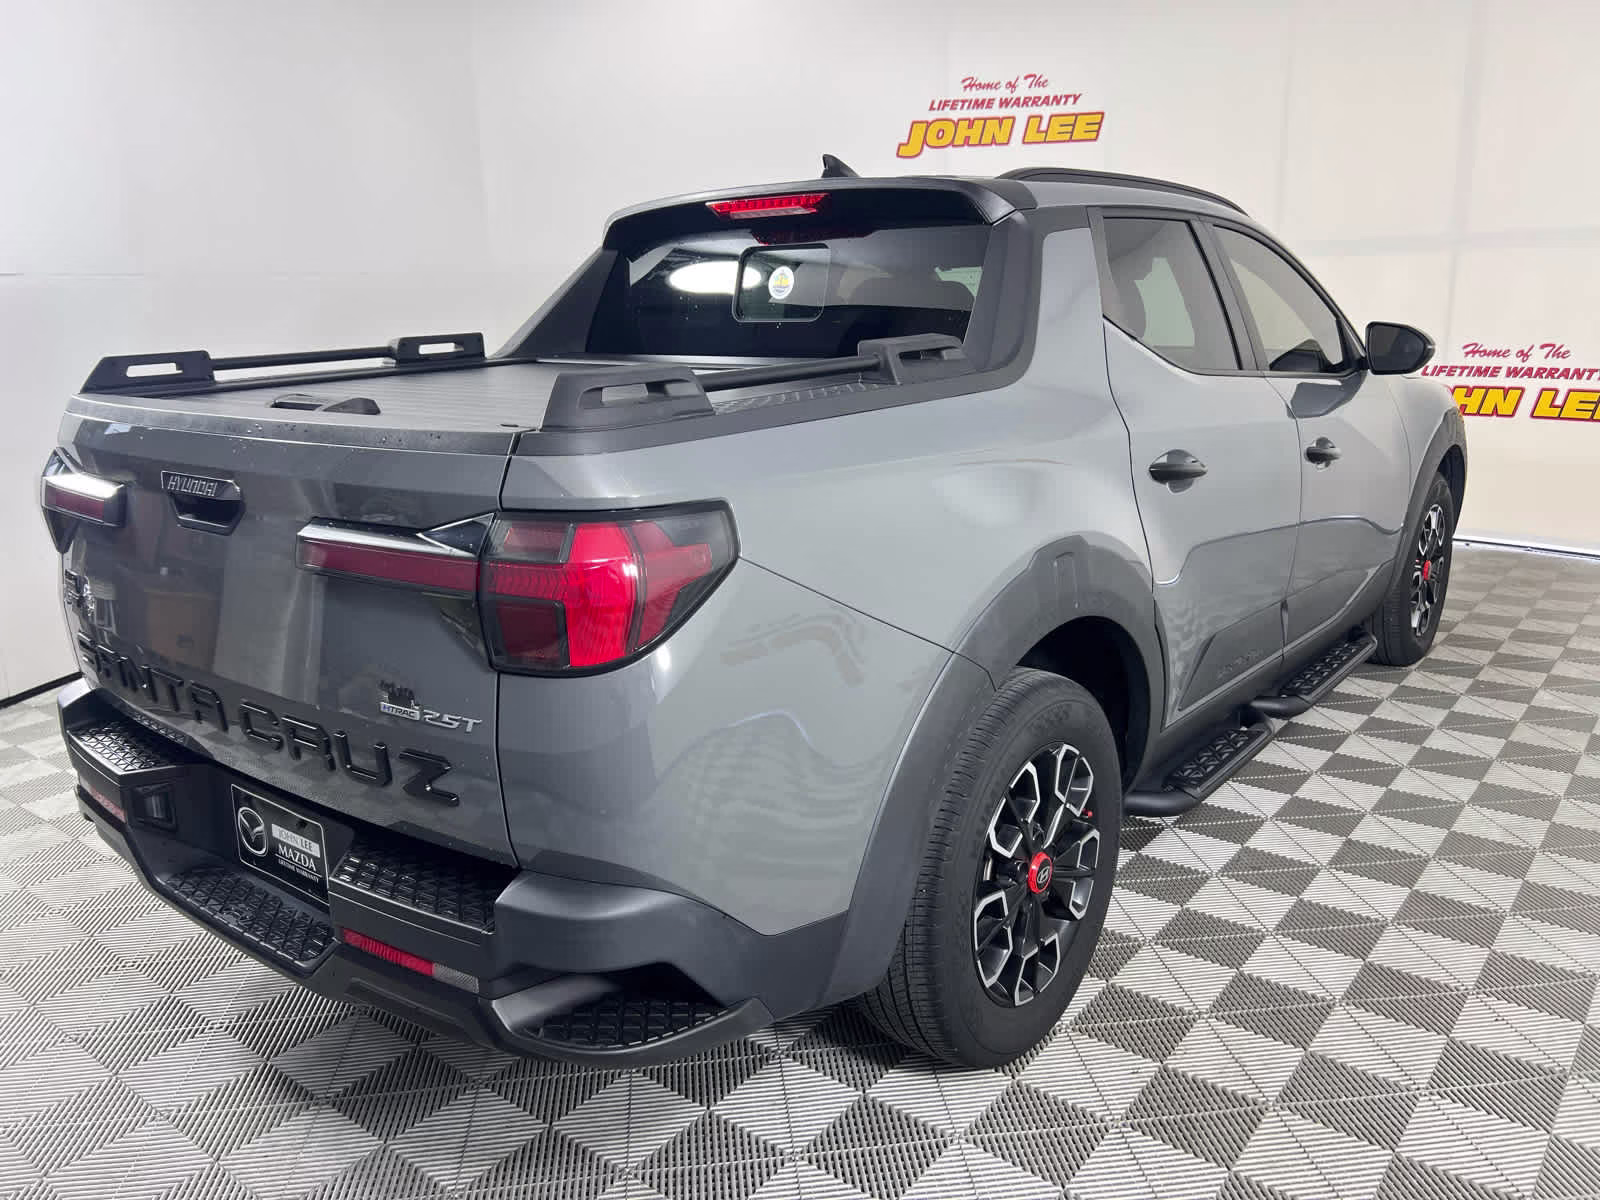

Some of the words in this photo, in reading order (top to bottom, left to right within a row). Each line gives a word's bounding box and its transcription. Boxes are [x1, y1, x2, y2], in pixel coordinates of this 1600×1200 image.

[961, 76, 1001, 92] Home
[1005, 77, 1020, 94] of
[1023, 74, 1049, 89] The
[928, 98, 994, 111] LIFETIME
[999, 93, 1082, 109] WARRANTY
[896, 116, 1016, 159] JOHN
[1022, 111, 1104, 144] LEE
[1462, 342, 1511, 359] Home
[1516, 344, 1535, 363] of
[1539, 343, 1571, 359] The
[1421, 365, 1500, 378] LIFETIME
[1505, 367, 1600, 380] WARRANT
[1449, 386, 1525, 418] HN
[167, 475, 218, 497] HYUNDAI
[382, 703, 416, 719] HTRAC
[239, 700, 459, 807] CRUZ
[278, 829, 300, 845] JOHN
[300, 839, 313, 850] LEE
[278, 843, 316, 872] MAZDA
